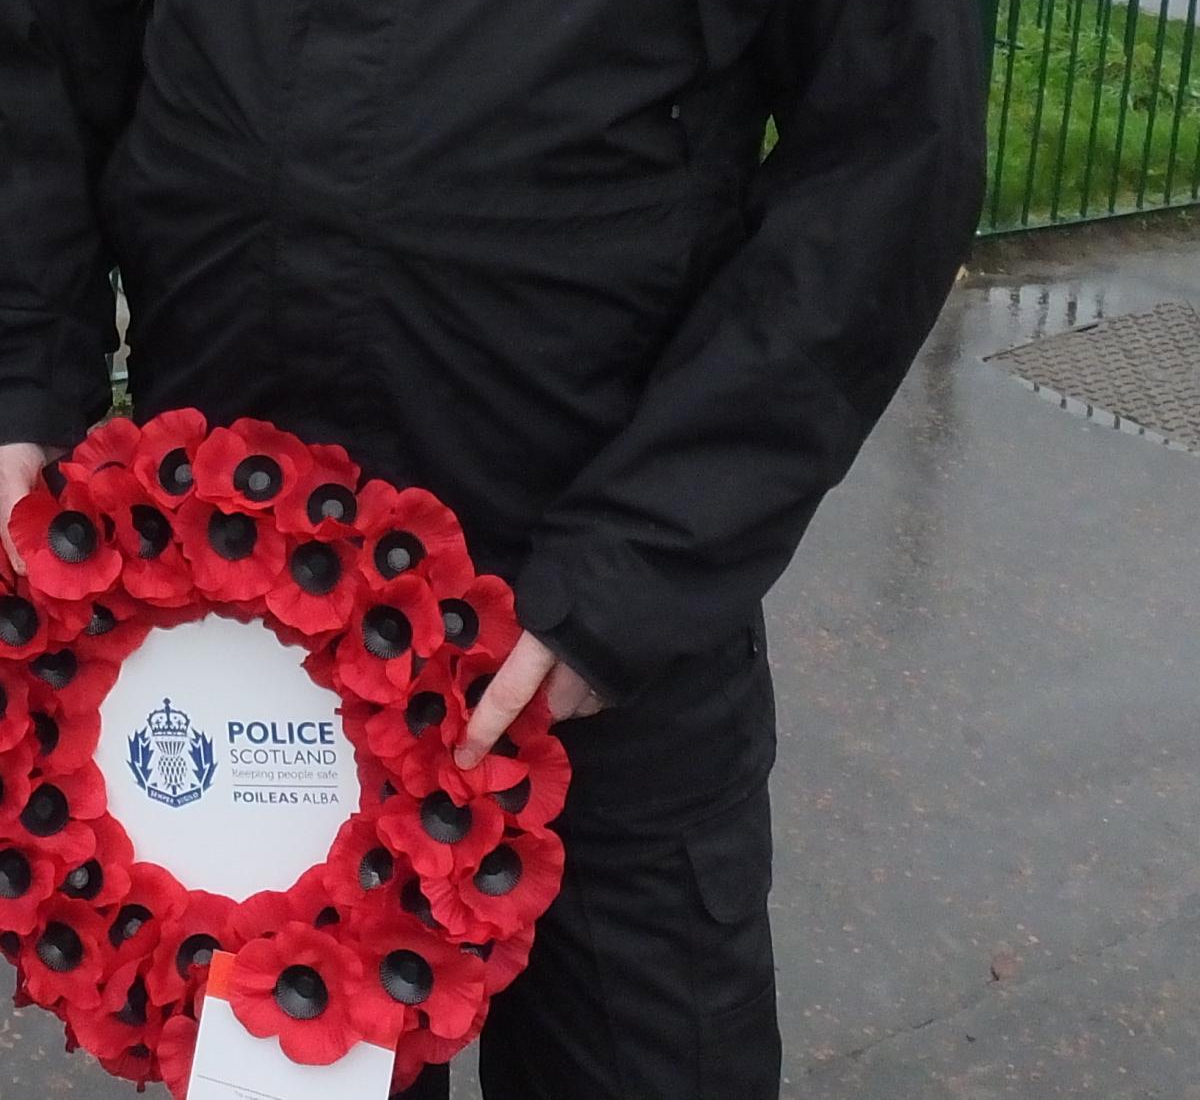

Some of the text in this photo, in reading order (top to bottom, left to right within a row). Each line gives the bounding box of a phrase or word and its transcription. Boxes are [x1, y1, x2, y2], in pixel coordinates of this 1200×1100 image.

[227, 721, 336, 745] POLICE
[230, 748, 337, 765] SCOTLAND
[231, 768, 339, 781] Keeping people safe
[233, 790, 340, 805] POILEAS ALBA
